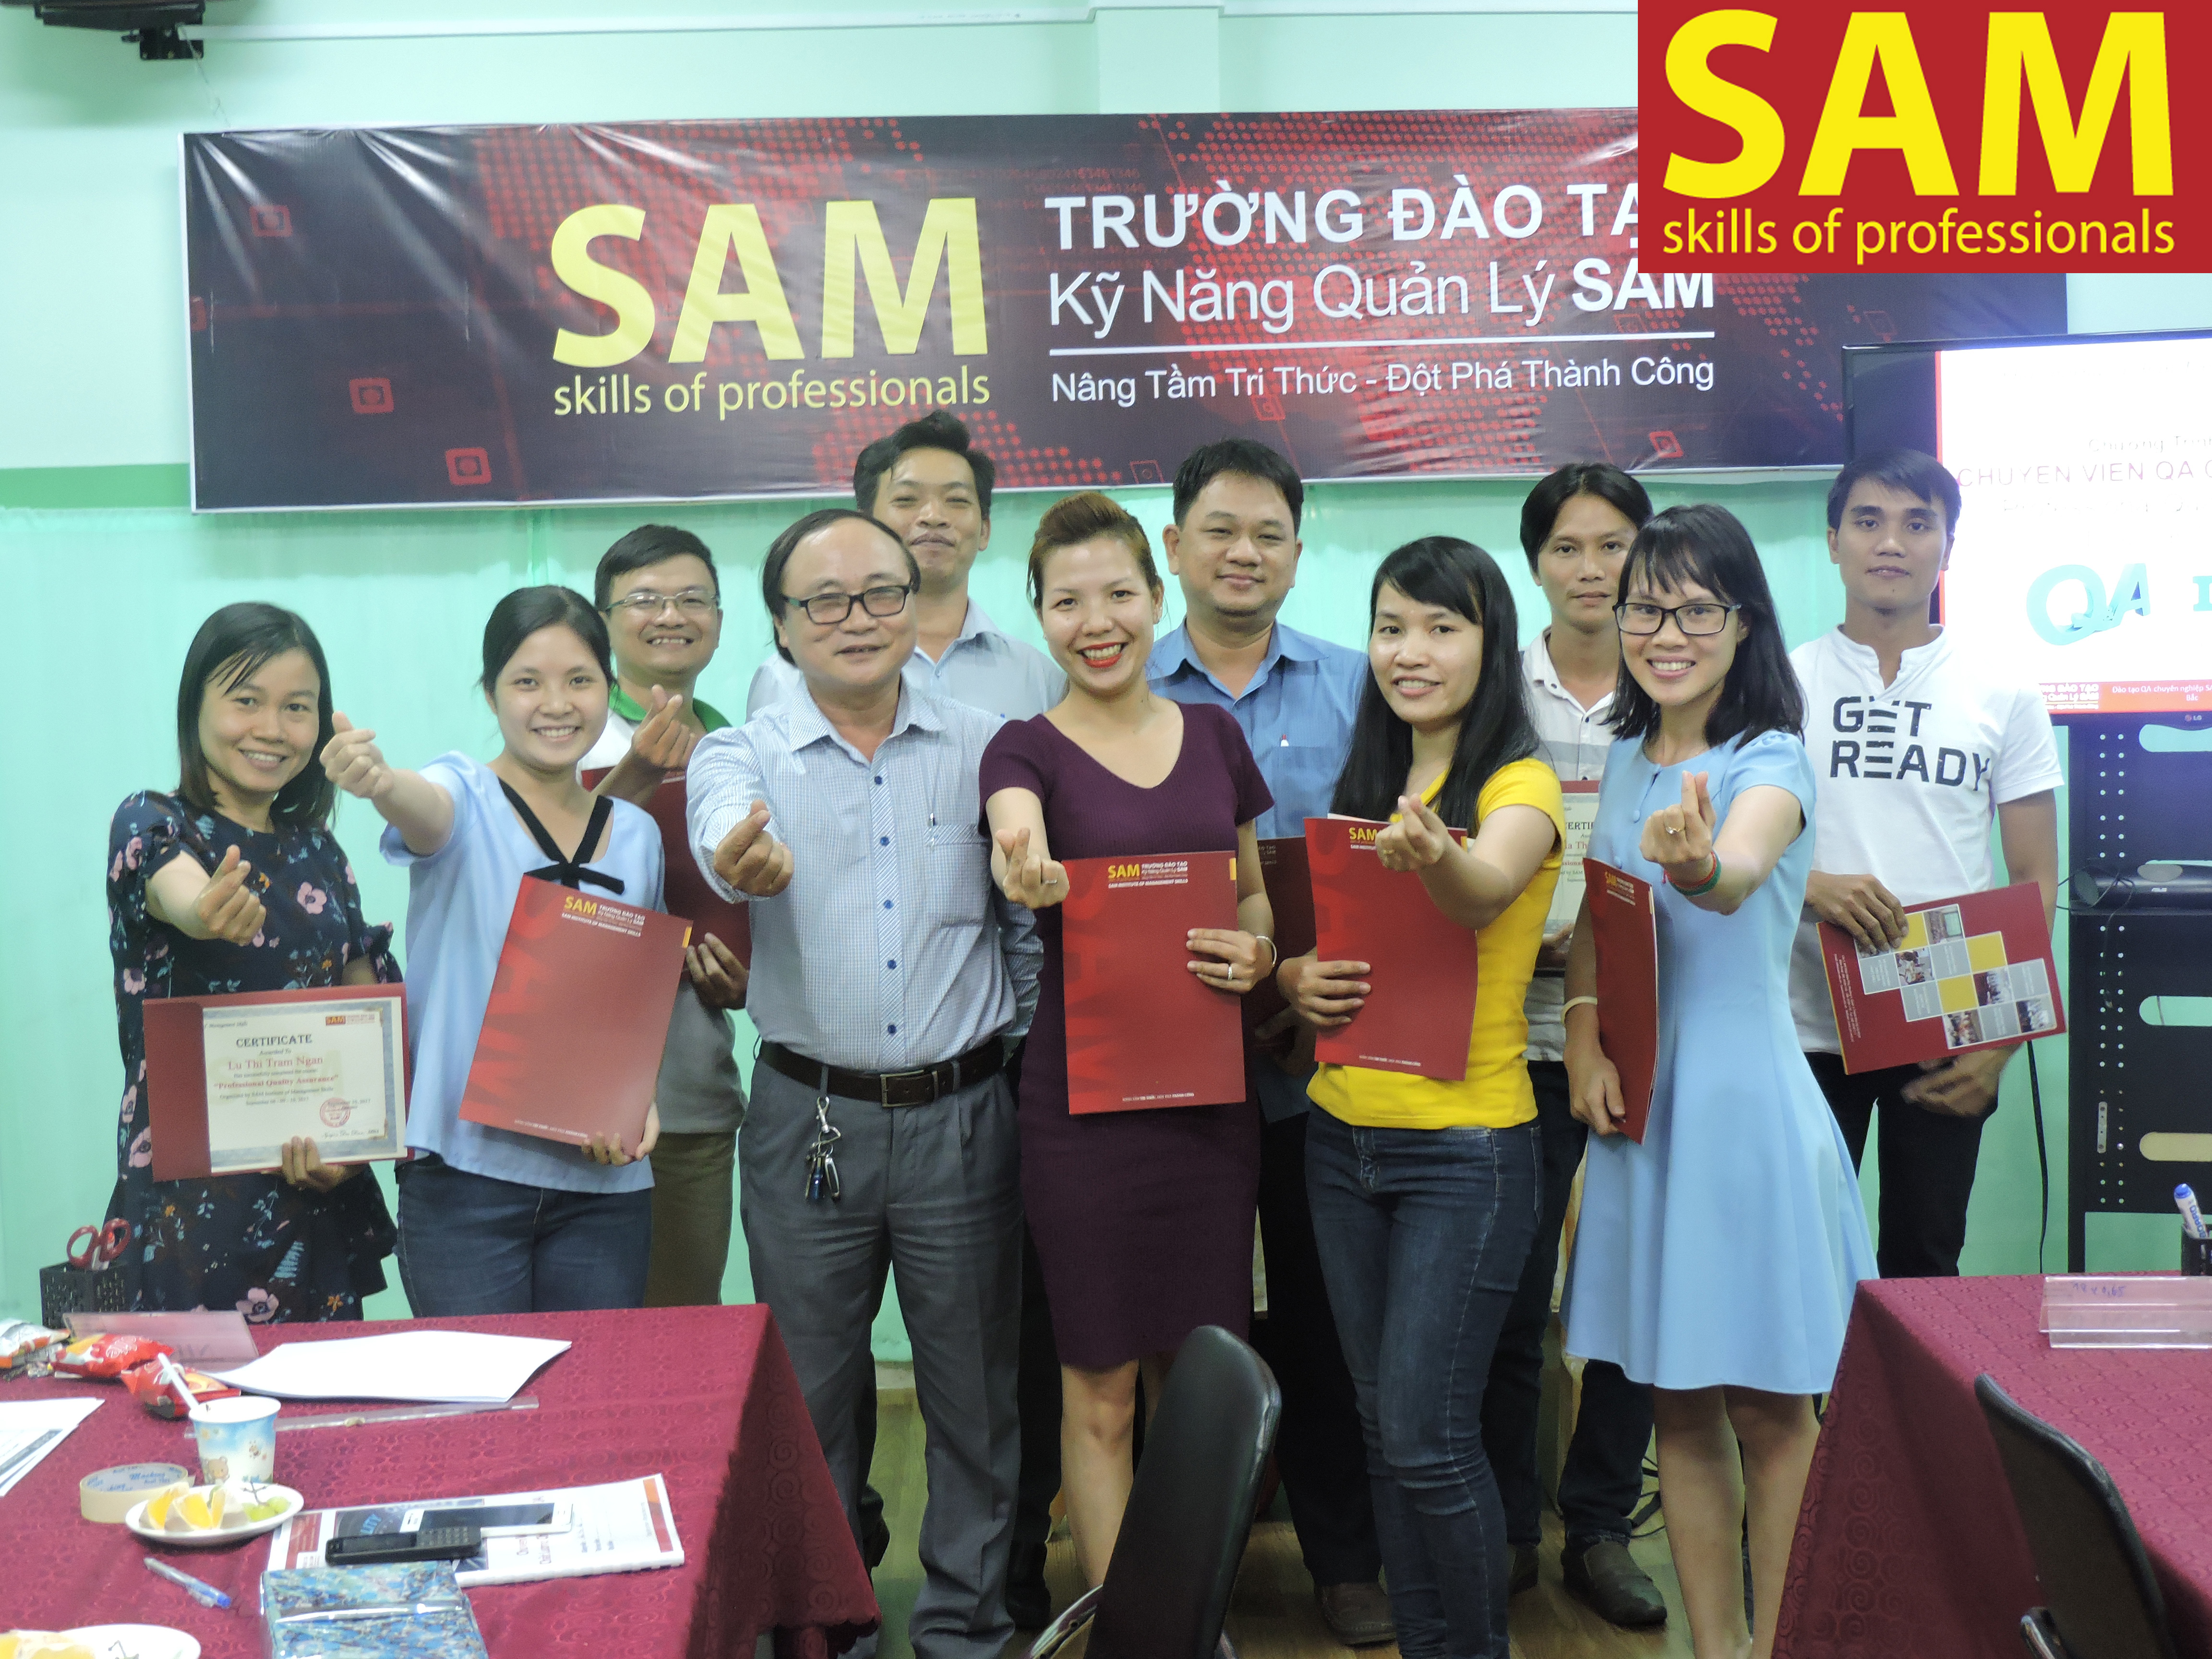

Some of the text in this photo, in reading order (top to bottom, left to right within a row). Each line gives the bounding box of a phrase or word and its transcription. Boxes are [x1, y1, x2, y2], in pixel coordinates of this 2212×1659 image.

[1045, 174, 1638, 250] TRƯỜNG ĐÀO TẠ
[551, 197, 988, 368] SAM
[1050, 257, 1714, 339] Kỹ Năng Quản Lý SAM
[553, 365, 990, 421] skills of professionals
[1052, 373, 1136, 408] Nâng
[1145, 363, 1216, 399] Tầm
[1225, 367, 1264, 397] Tri
[1273, 365, 1358, 395] Thức
[1386, 362, 1442, 397] Đột
[1451, 361, 1513, 390] Phá
[1521, 358, 1621, 388] Thành
[1631, 355, 1715, 392] Công
[2156, 460, 2194, 481] QA
[2026, 563, 2151, 646] QA
[1833, 696, 1932, 737] GET
[1830, 740, 1990, 791] READY
[1349, 827, 1377, 841] SAM
[1108, 864, 1140, 879] SAM
[564, 895, 598, 916] SAM
[236, 1034, 313, 1047] CERTIFICATE
[297, 1055, 324, 1067] Ngan
